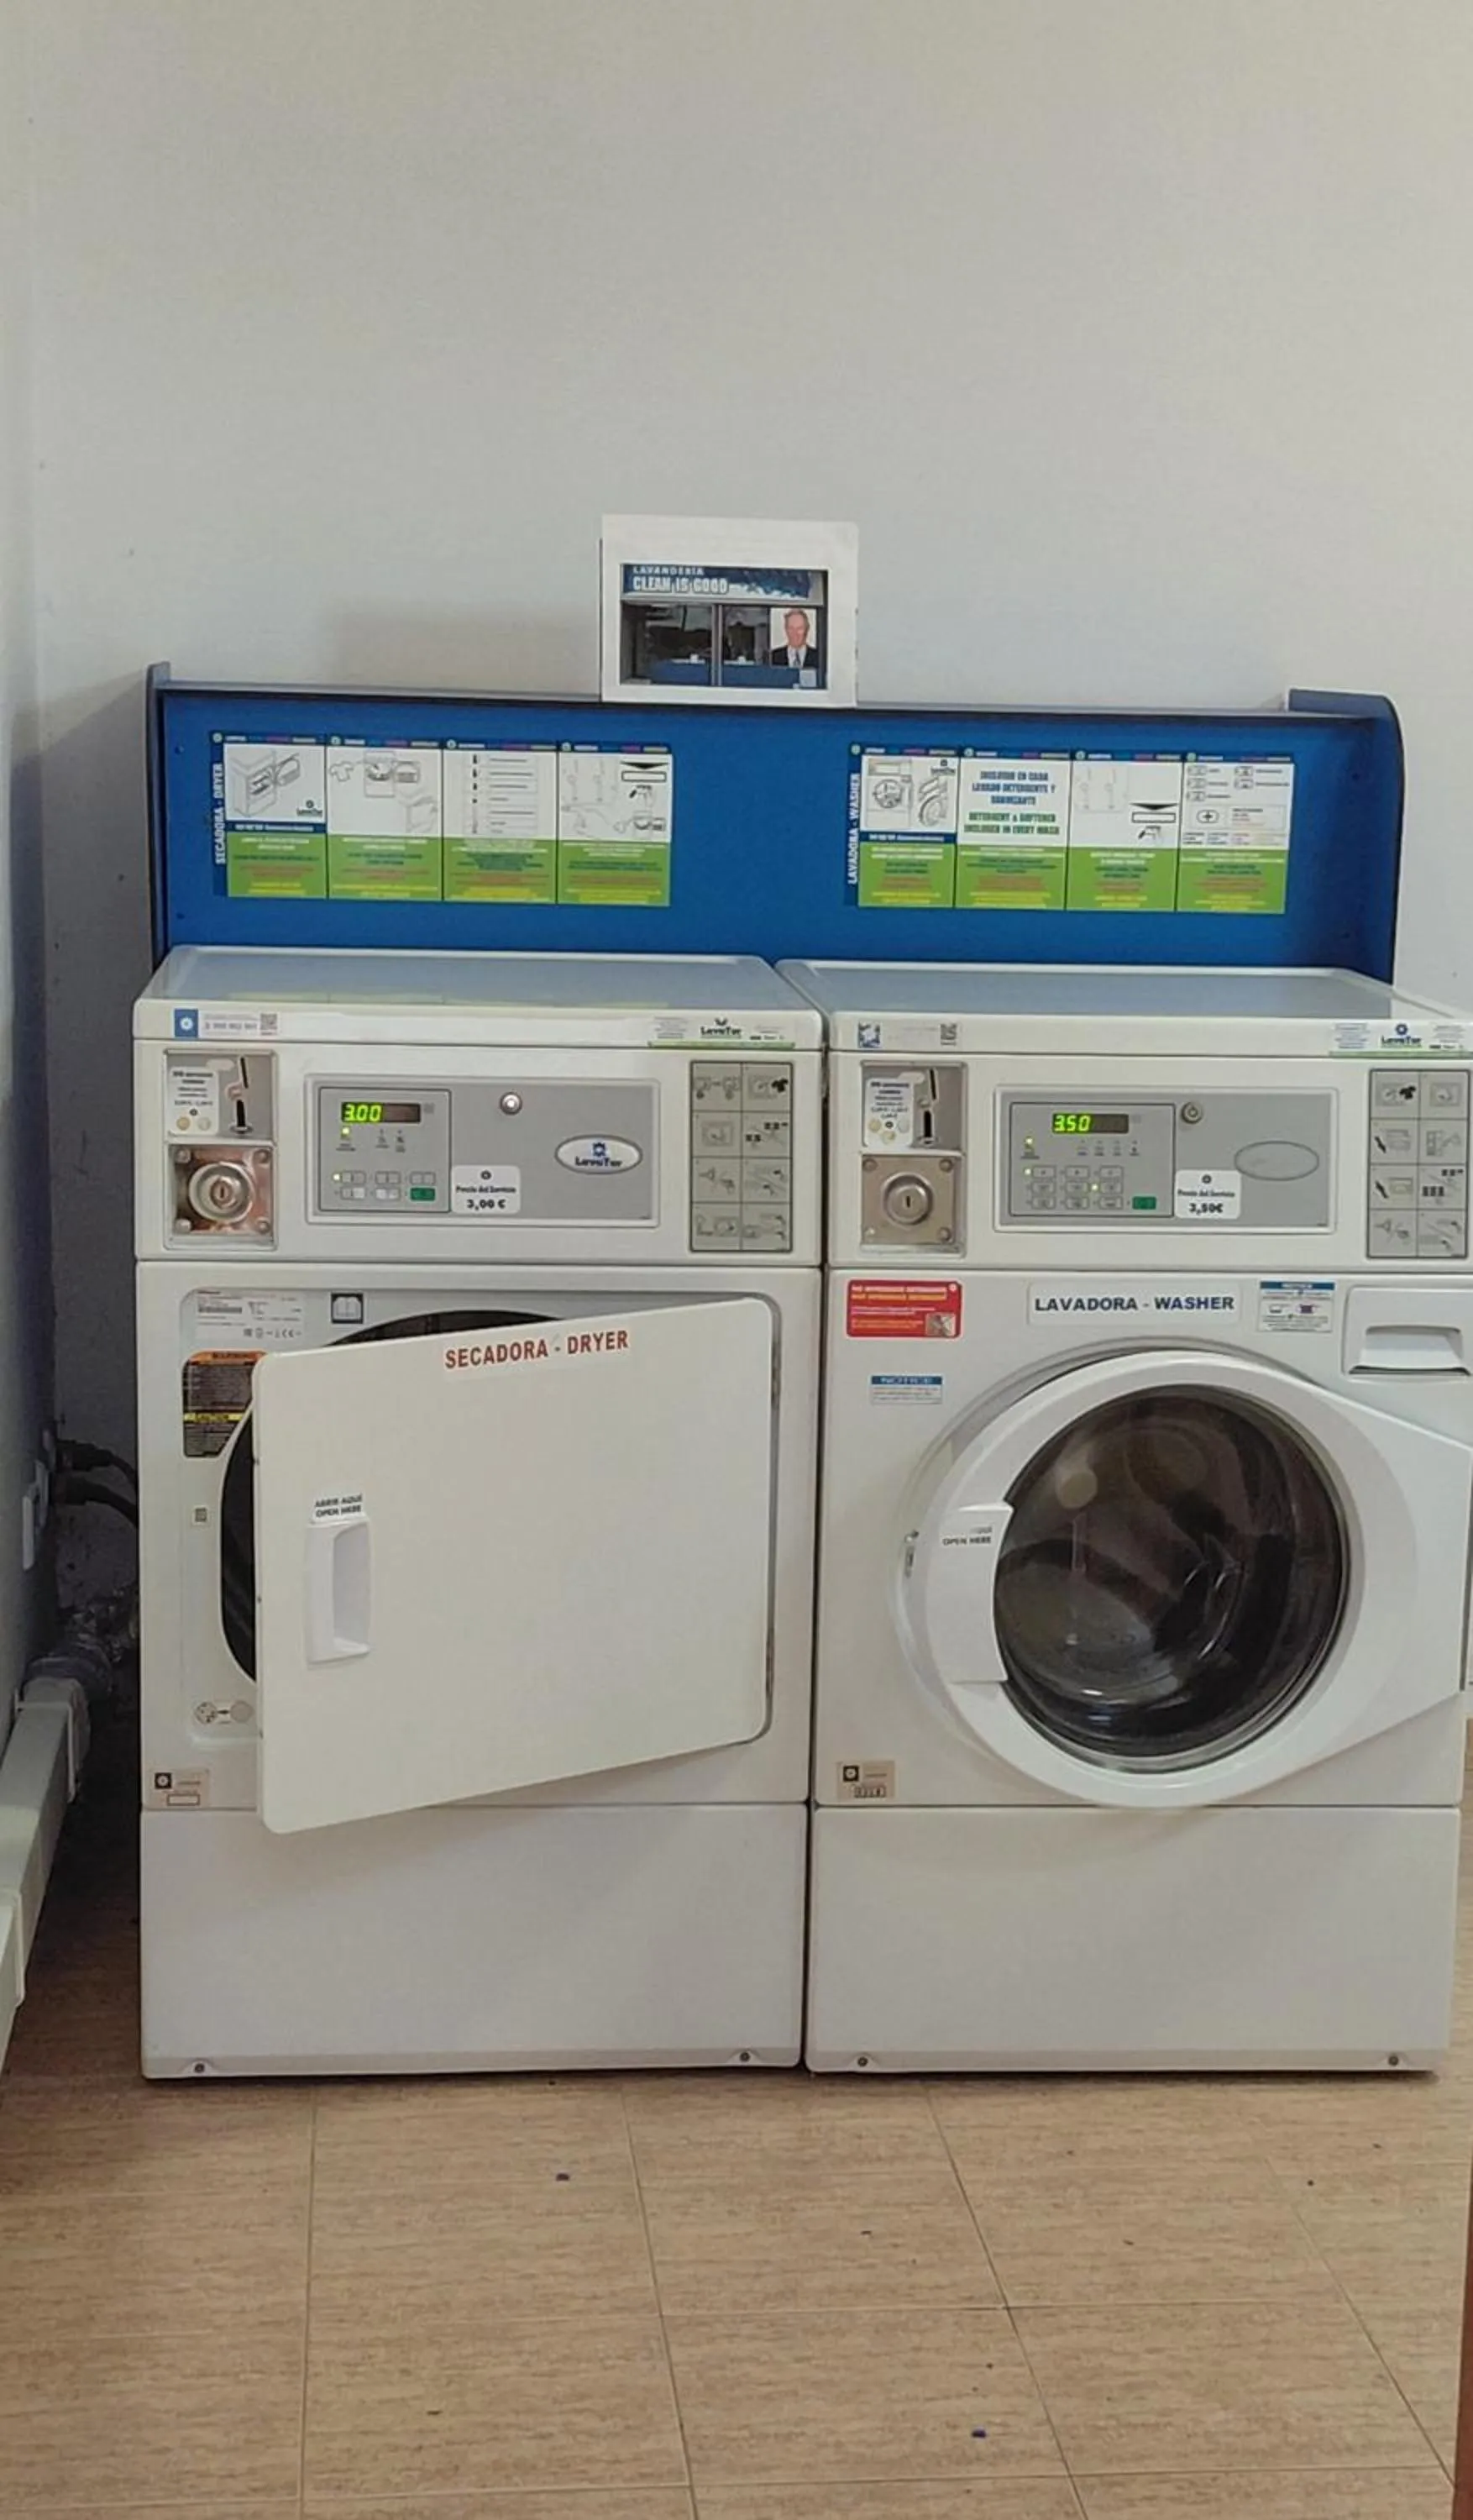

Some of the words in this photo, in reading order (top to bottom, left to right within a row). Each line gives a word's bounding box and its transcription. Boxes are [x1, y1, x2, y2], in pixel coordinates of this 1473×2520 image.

[632, 575, 671, 591] CLEAN
[675, 577, 689, 592] IS
[693, 577, 728, 593] GOOD
[212, 764, 224, 799] DRYER
[214, 807, 226, 864] SECADORA
[1034, 1297, 1139, 1312] LAVADORA
[1153, 1295, 1234, 1310] WASHER
[444, 1338, 549, 1369] SECADORA
[566, 1329, 629, 1355] DRYER
[942, 1537, 967, 1546] OPEN
